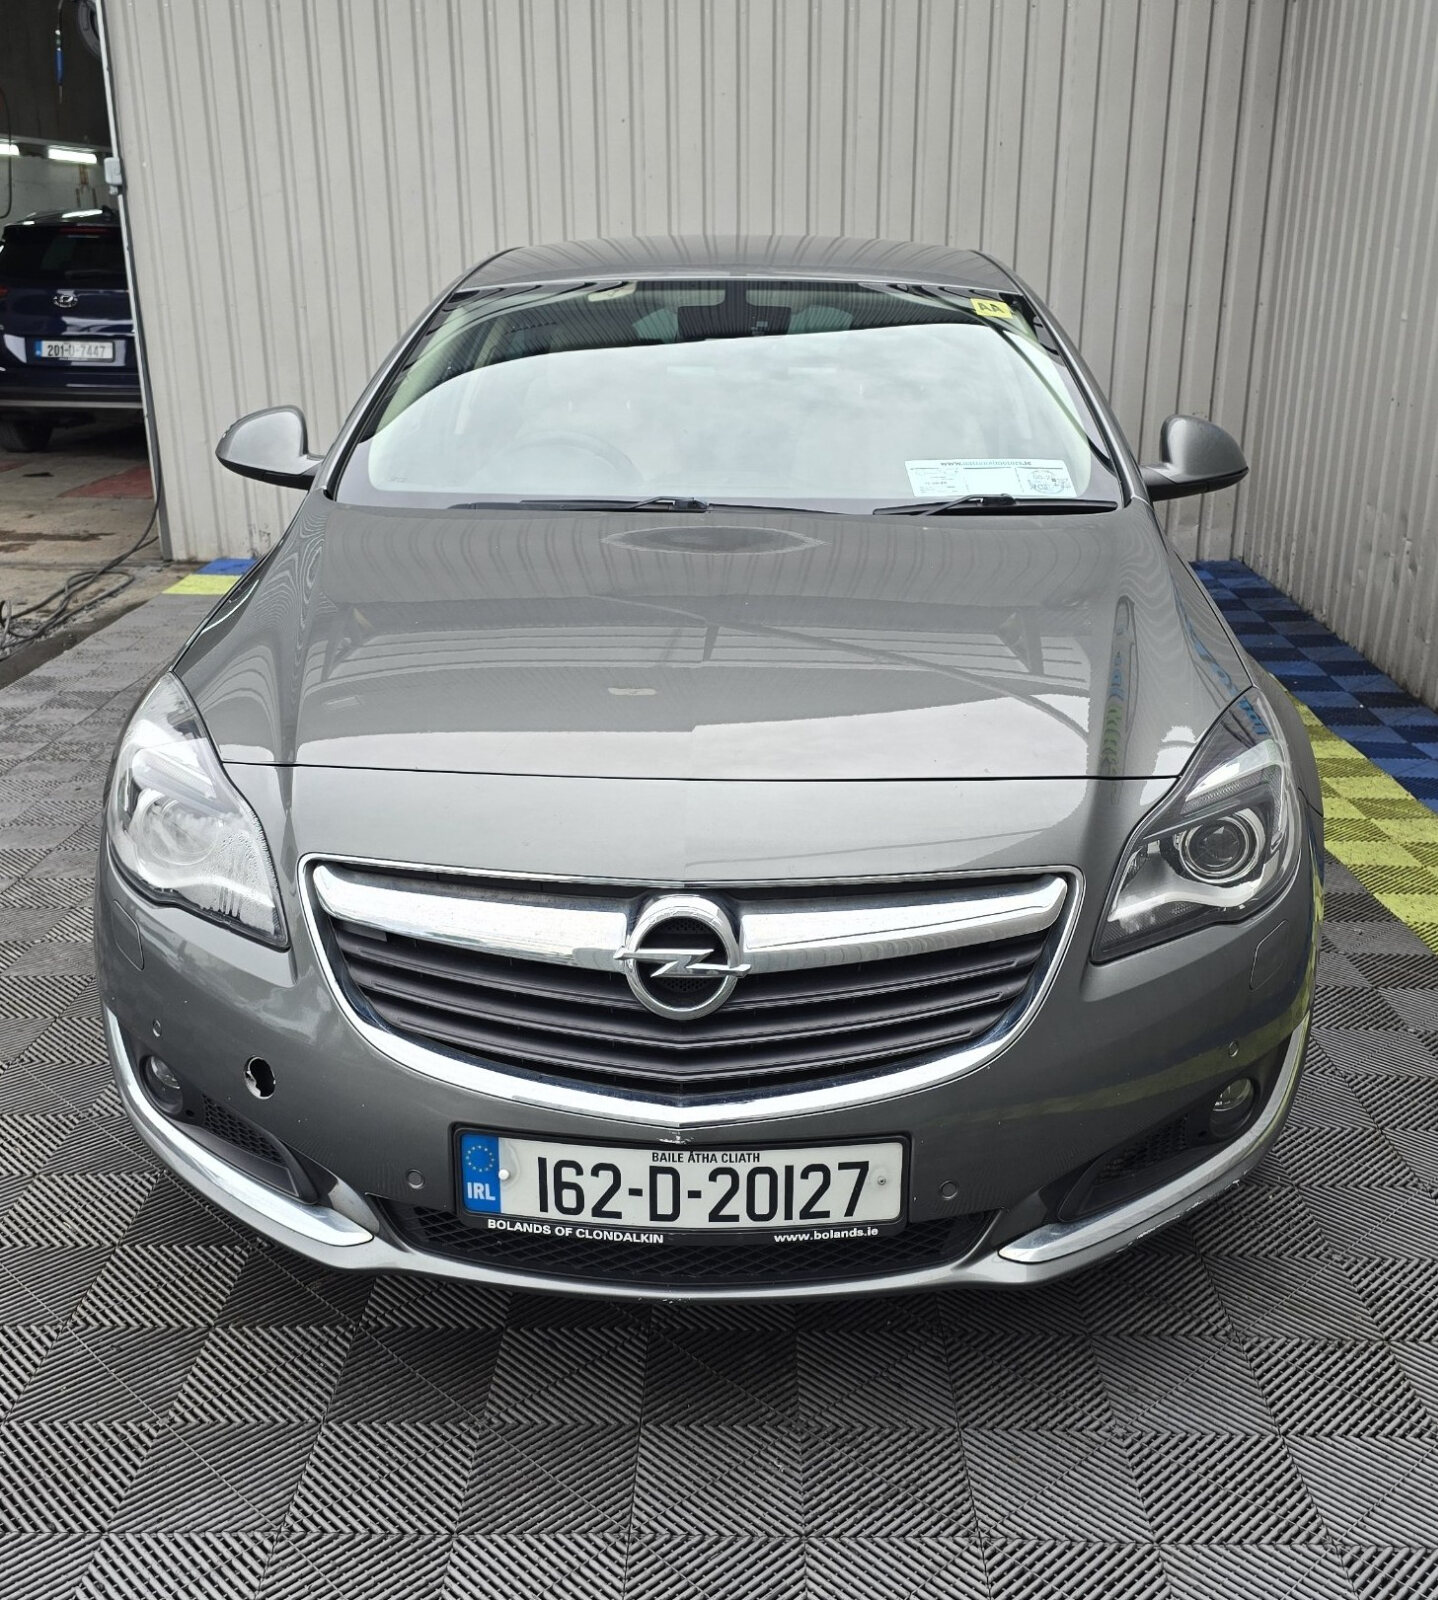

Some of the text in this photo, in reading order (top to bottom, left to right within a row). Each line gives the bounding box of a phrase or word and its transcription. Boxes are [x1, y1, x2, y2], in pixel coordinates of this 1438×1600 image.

[977, 302, 1005, 314] AA
[47, 344, 106, 357] 201-D-7447
[651, 1152, 684, 1163] BAILE
[721, 1153, 760, 1163] CLIATH
[467, 1182, 496, 1201] IRL
[537, 1156, 870, 1223] 162-D-20127
[487, 1218, 664, 1244] BOLANDS OF CLONDALKIN
[773, 1226, 879, 1243] www.bolands.ie
